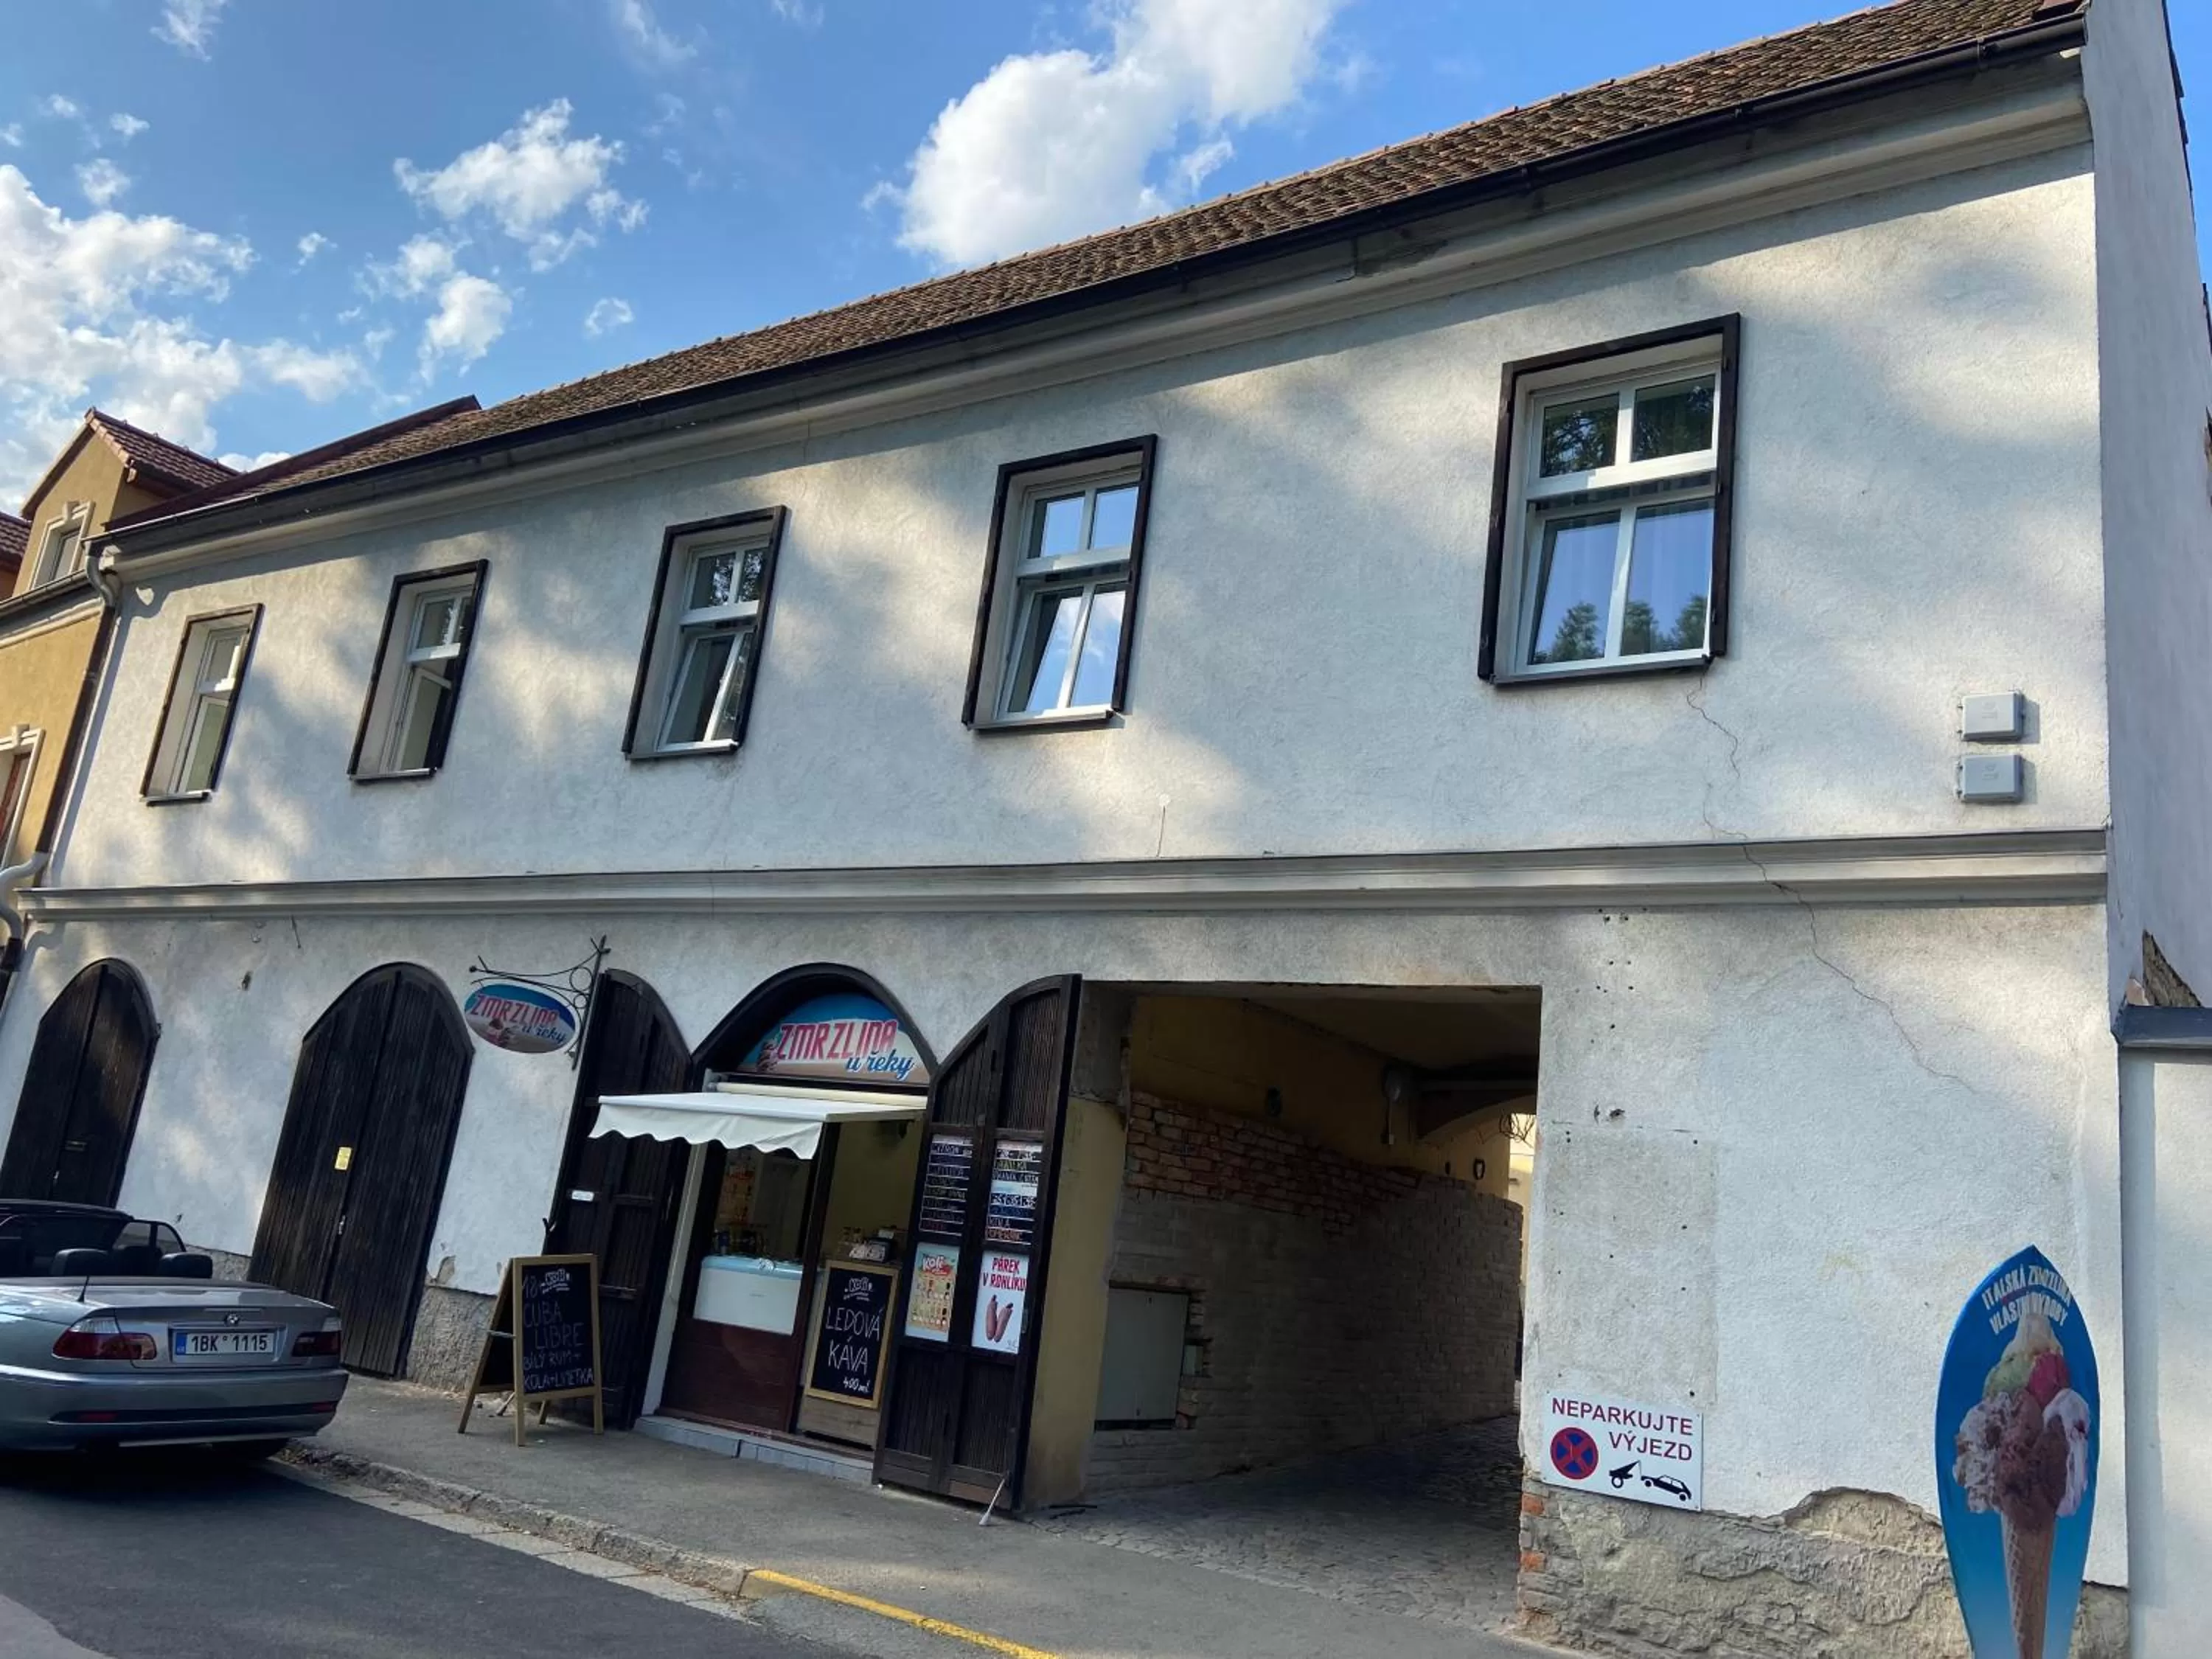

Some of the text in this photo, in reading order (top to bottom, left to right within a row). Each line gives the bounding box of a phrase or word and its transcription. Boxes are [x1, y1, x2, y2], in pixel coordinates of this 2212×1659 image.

[470, 994, 559, 1026] ZMRZLINA
[778, 1020, 897, 1060] ZMRZLINA
[847, 1048, 914, 1080] u řeky
[992, 1256, 1020, 1273] PÁREK
[1981, 1263, 2027, 1310] ITALSKÁ
[524, 1300, 563, 1328] CUBA
[825, 1307, 884, 1341] LEDOVÁ
[232, 1335, 268, 1352] 1115
[535, 1322, 584, 1349] LIBRE
[827, 1336, 869, 1376] KÁVA
[1552, 1397, 1693, 1436] NEPARKUJTE
[1609, 1430, 1692, 1461] VÝJEZD
